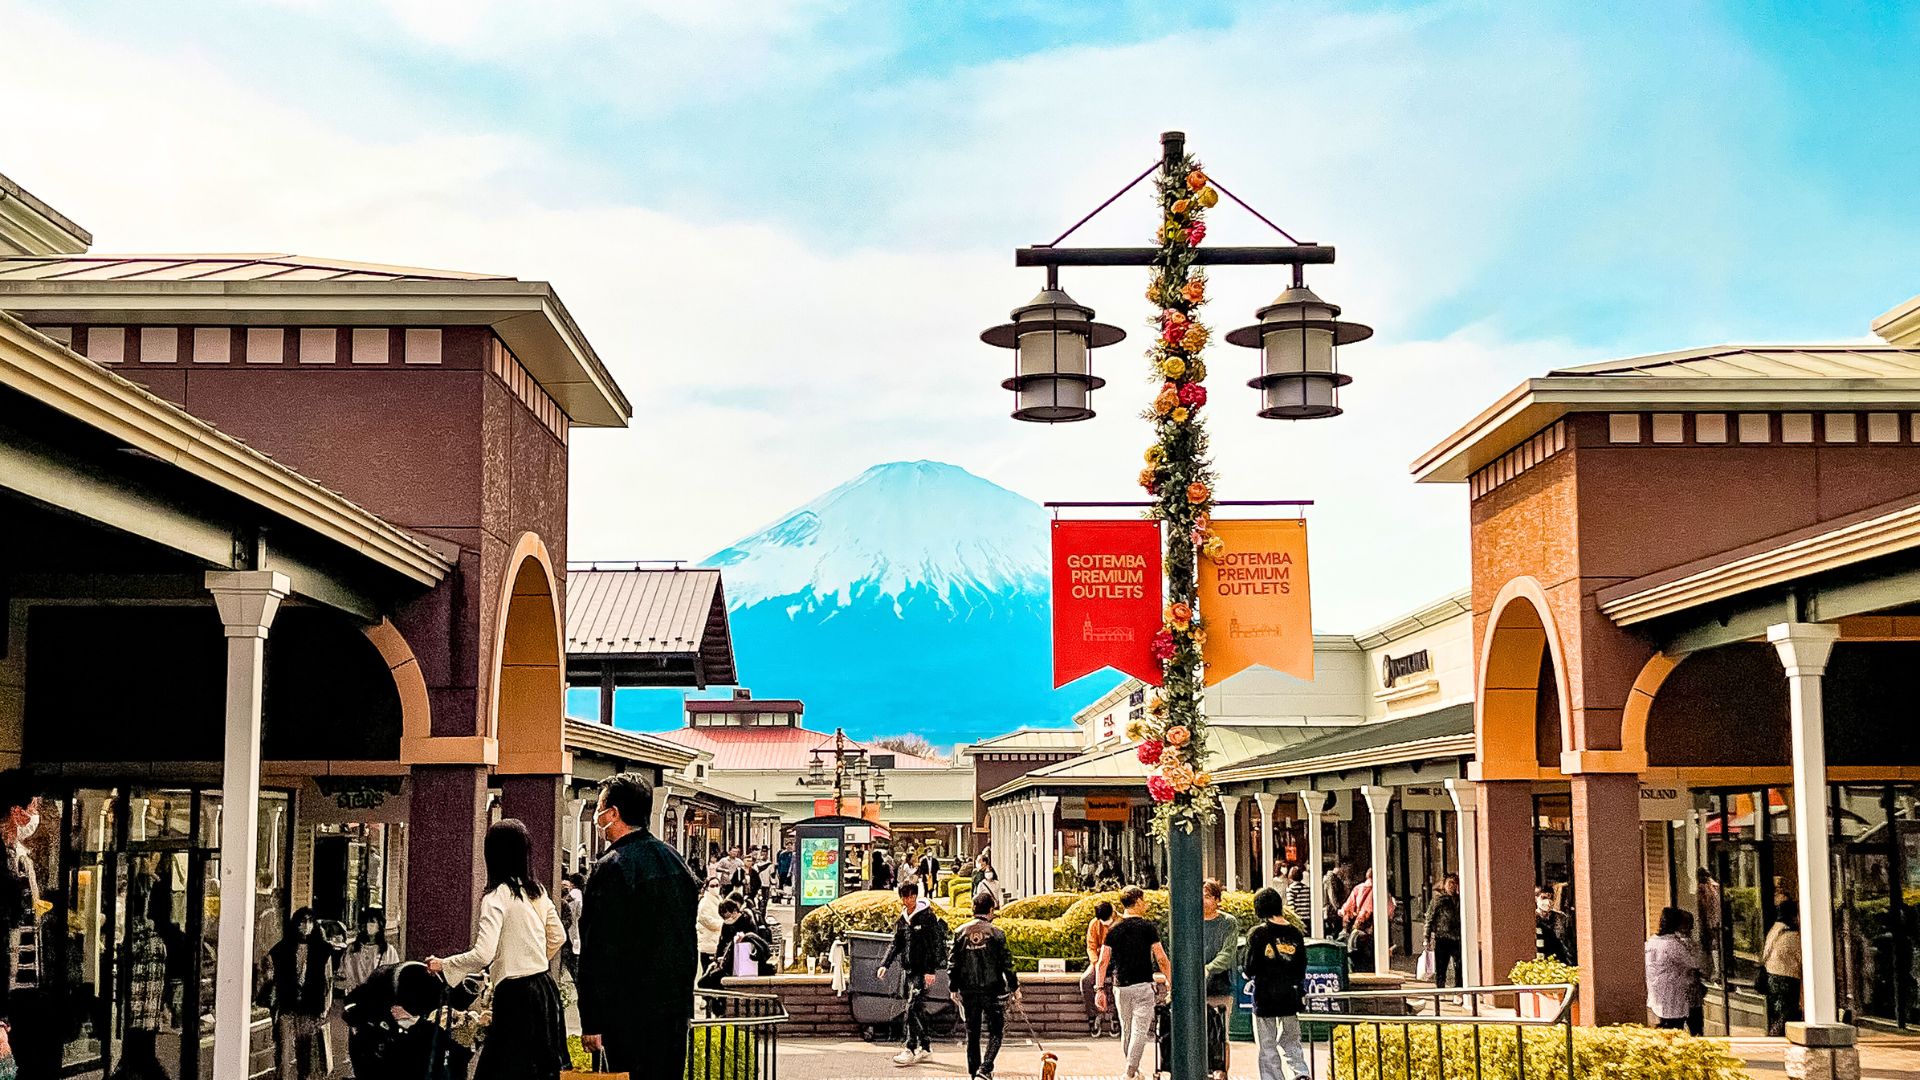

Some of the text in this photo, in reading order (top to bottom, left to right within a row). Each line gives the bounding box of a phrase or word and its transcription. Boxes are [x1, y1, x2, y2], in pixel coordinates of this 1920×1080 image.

[1067, 554, 1147, 569] GOTEMBA
[1213, 552, 1292, 567] GOTEMBA
[1071, 569, 1143, 584] PREMIUM
[1217, 566, 1290, 581] PREMIUM
[1071, 584, 1143, 599] OUTLETS
[1218, 581, 1290, 596] OUTLETS
[1640, 789, 1678, 800] ISLAND
